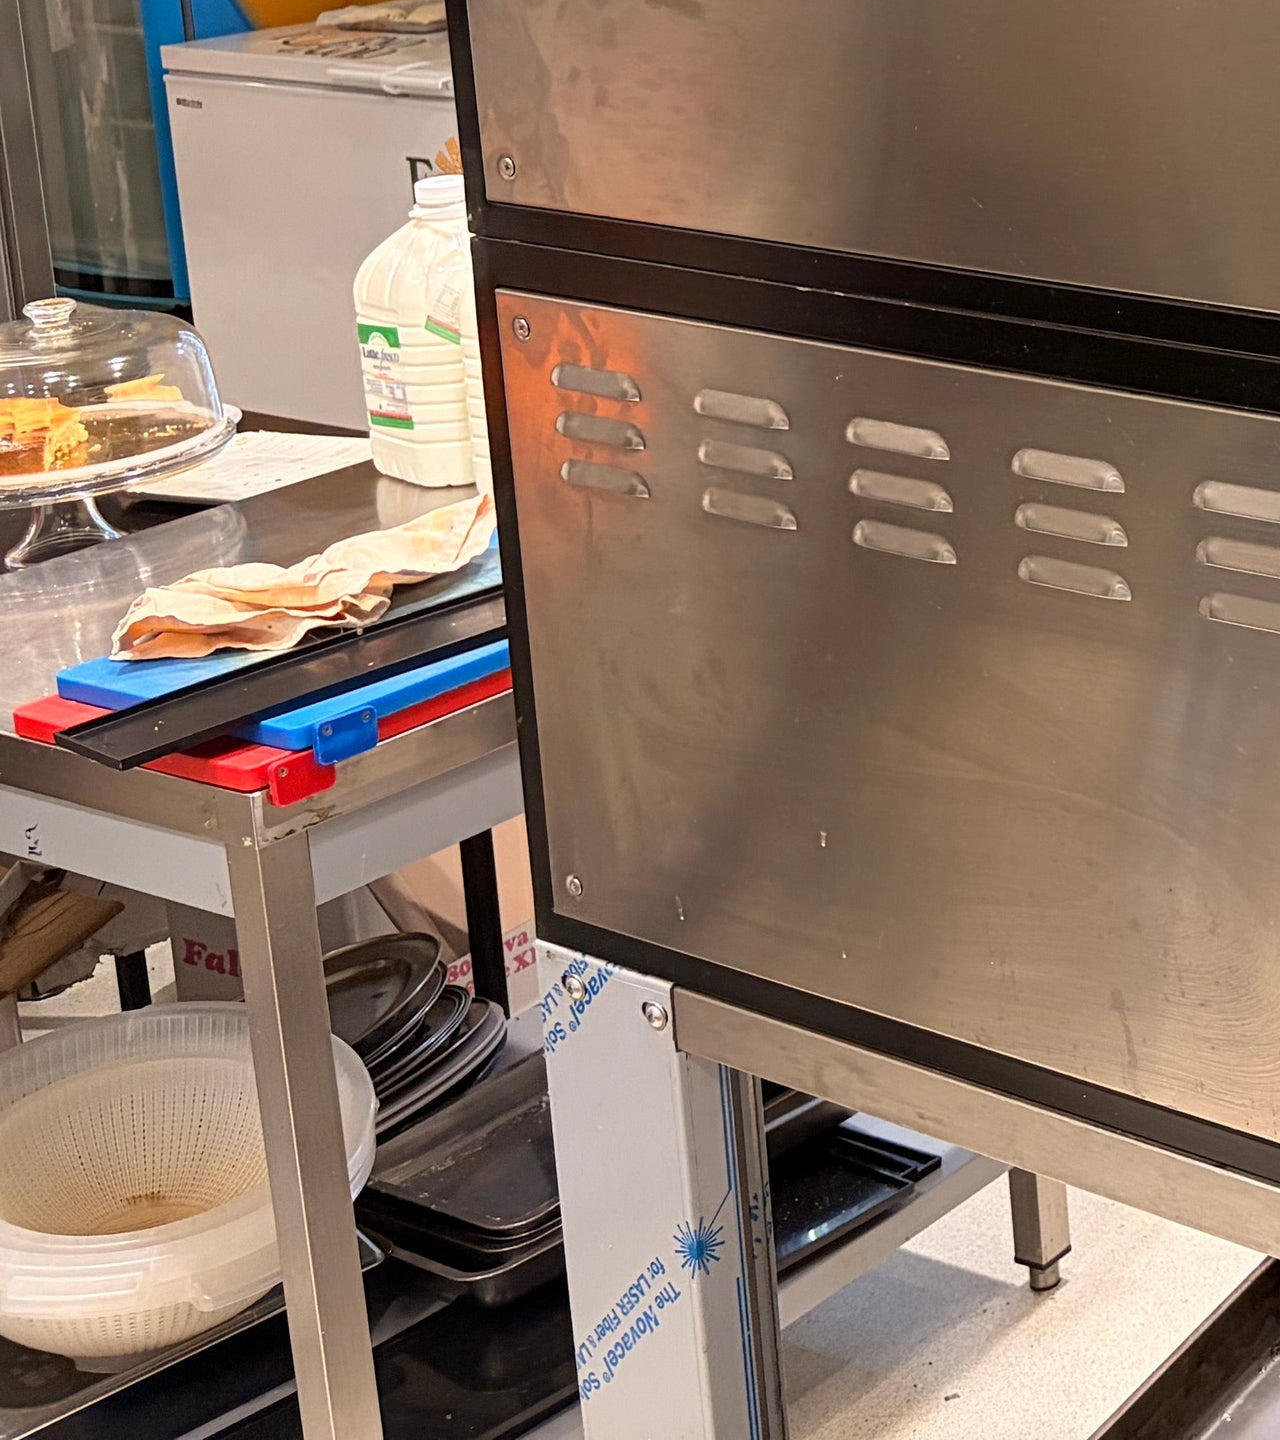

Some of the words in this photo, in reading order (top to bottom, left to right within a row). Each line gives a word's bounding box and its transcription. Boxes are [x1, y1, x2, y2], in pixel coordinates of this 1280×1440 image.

[616, 1273, 651, 1317] LASER
[655, 1281, 682, 1310] The
[586, 1334, 597, 1349] &
[594, 1308, 622, 1343] Fiber
